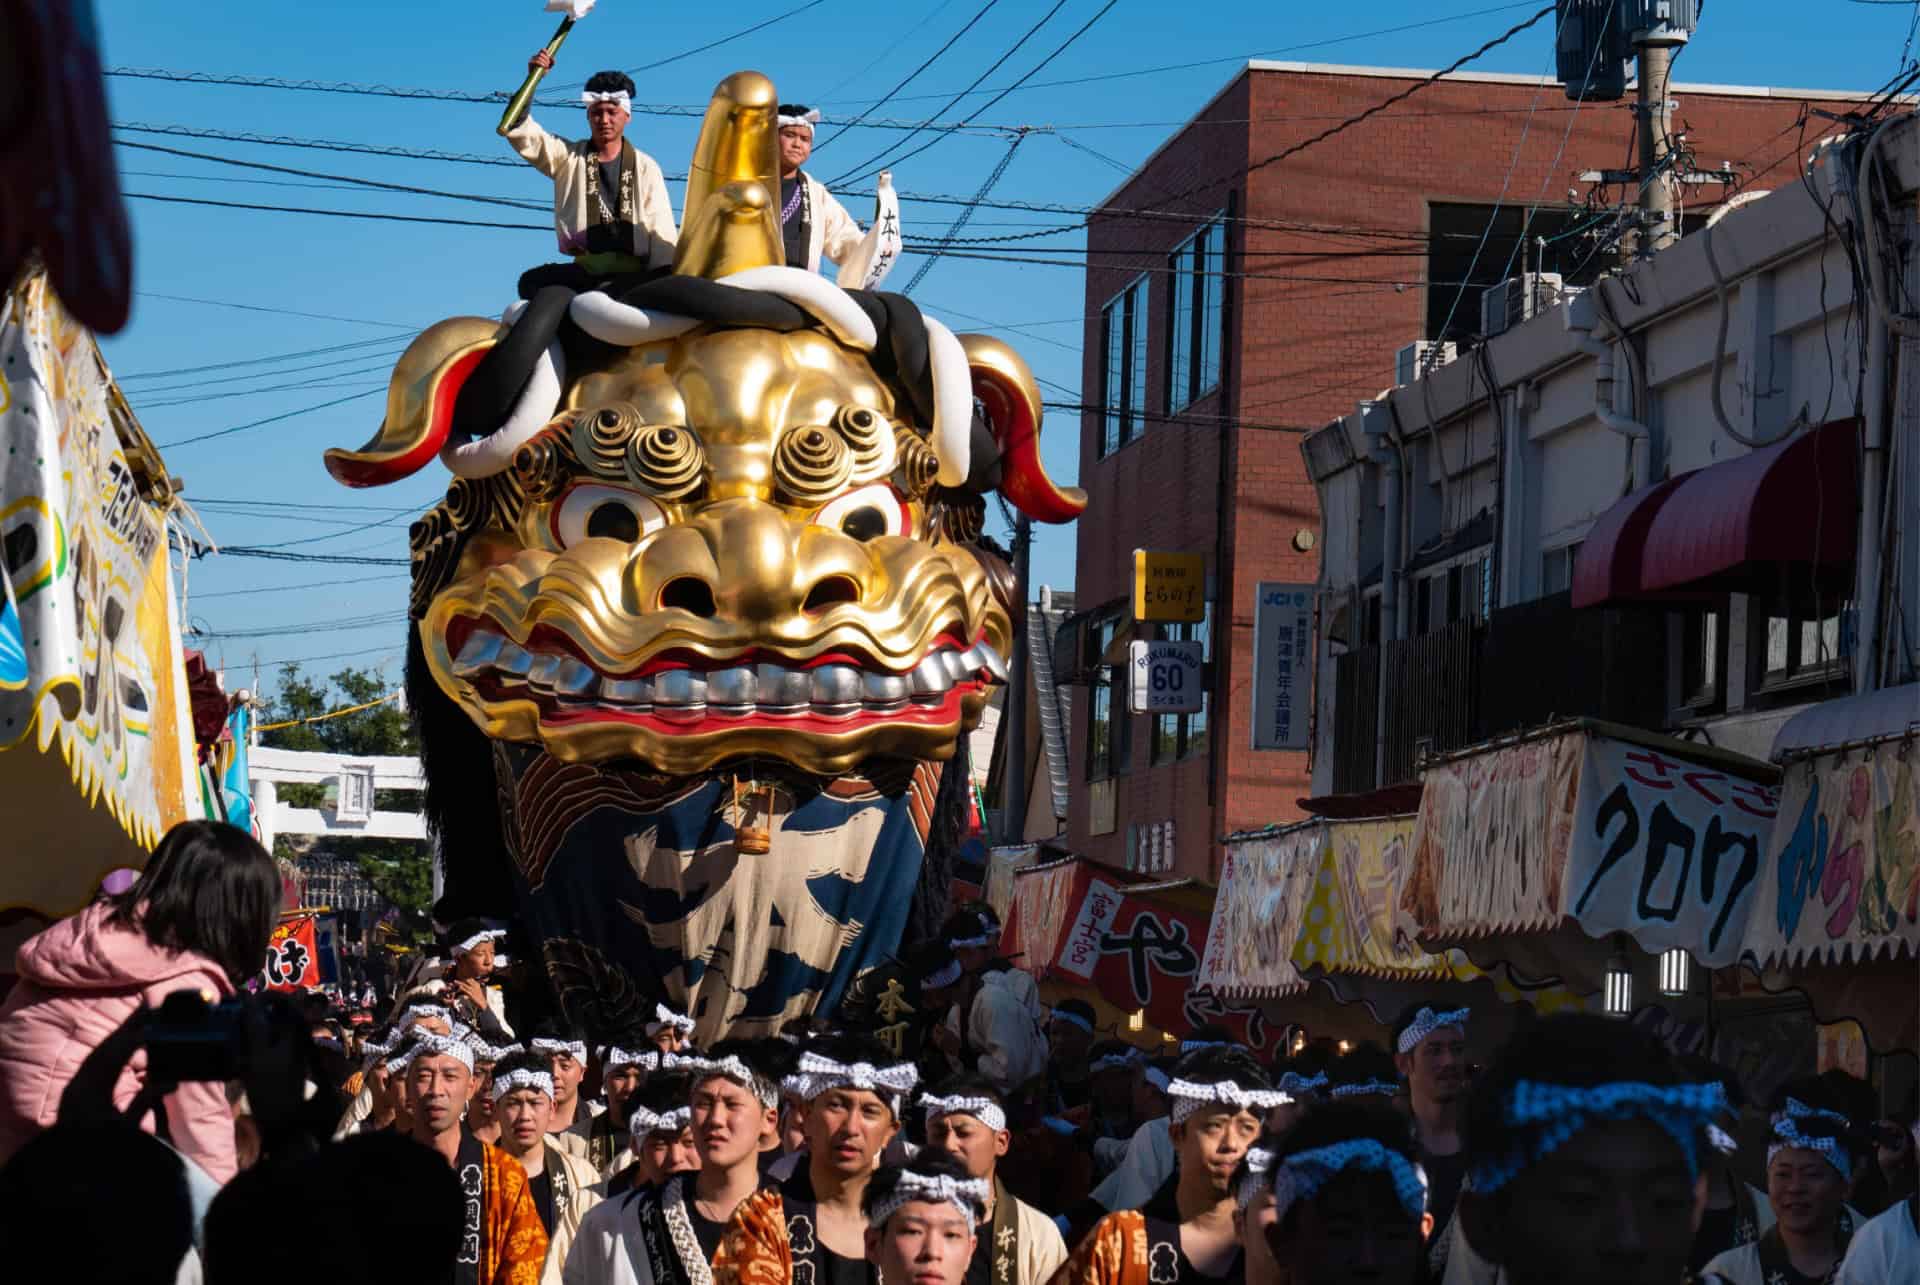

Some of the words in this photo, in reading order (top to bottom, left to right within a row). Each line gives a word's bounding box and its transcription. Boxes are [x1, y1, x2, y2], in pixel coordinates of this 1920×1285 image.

[1263, 592, 1290, 606] JCI
[1137, 647, 1199, 669] ROKUMARU
[1152, 664, 1183, 691] 60
[872, 977, 919, 1057] 本町
